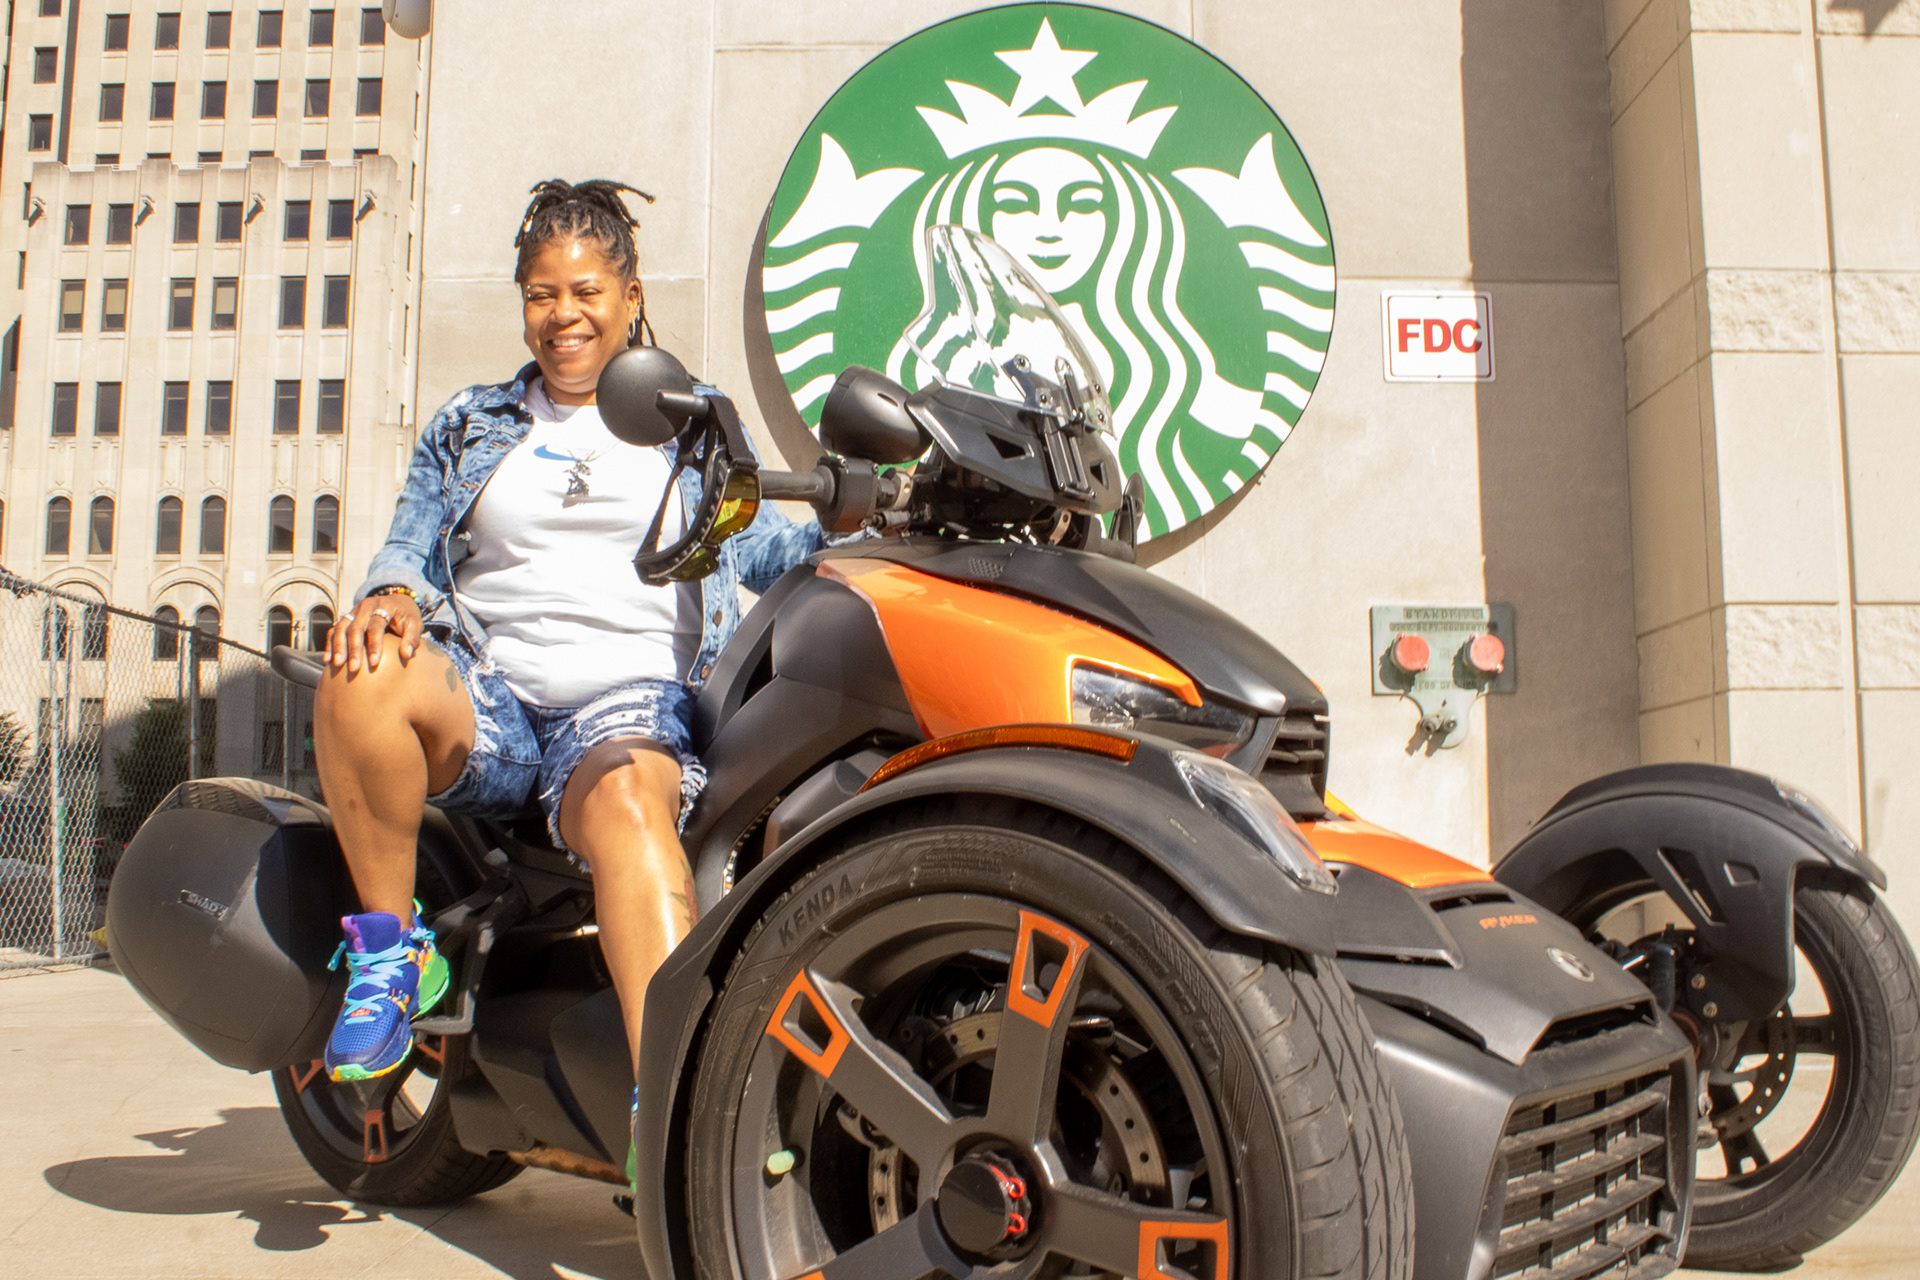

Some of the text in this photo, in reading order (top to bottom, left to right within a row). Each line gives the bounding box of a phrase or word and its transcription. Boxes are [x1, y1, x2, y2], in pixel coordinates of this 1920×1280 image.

[1397, 318, 1482, 354] FDC
[186, 893, 219, 913] SHAD
[778, 873, 855, 949] KENDA
